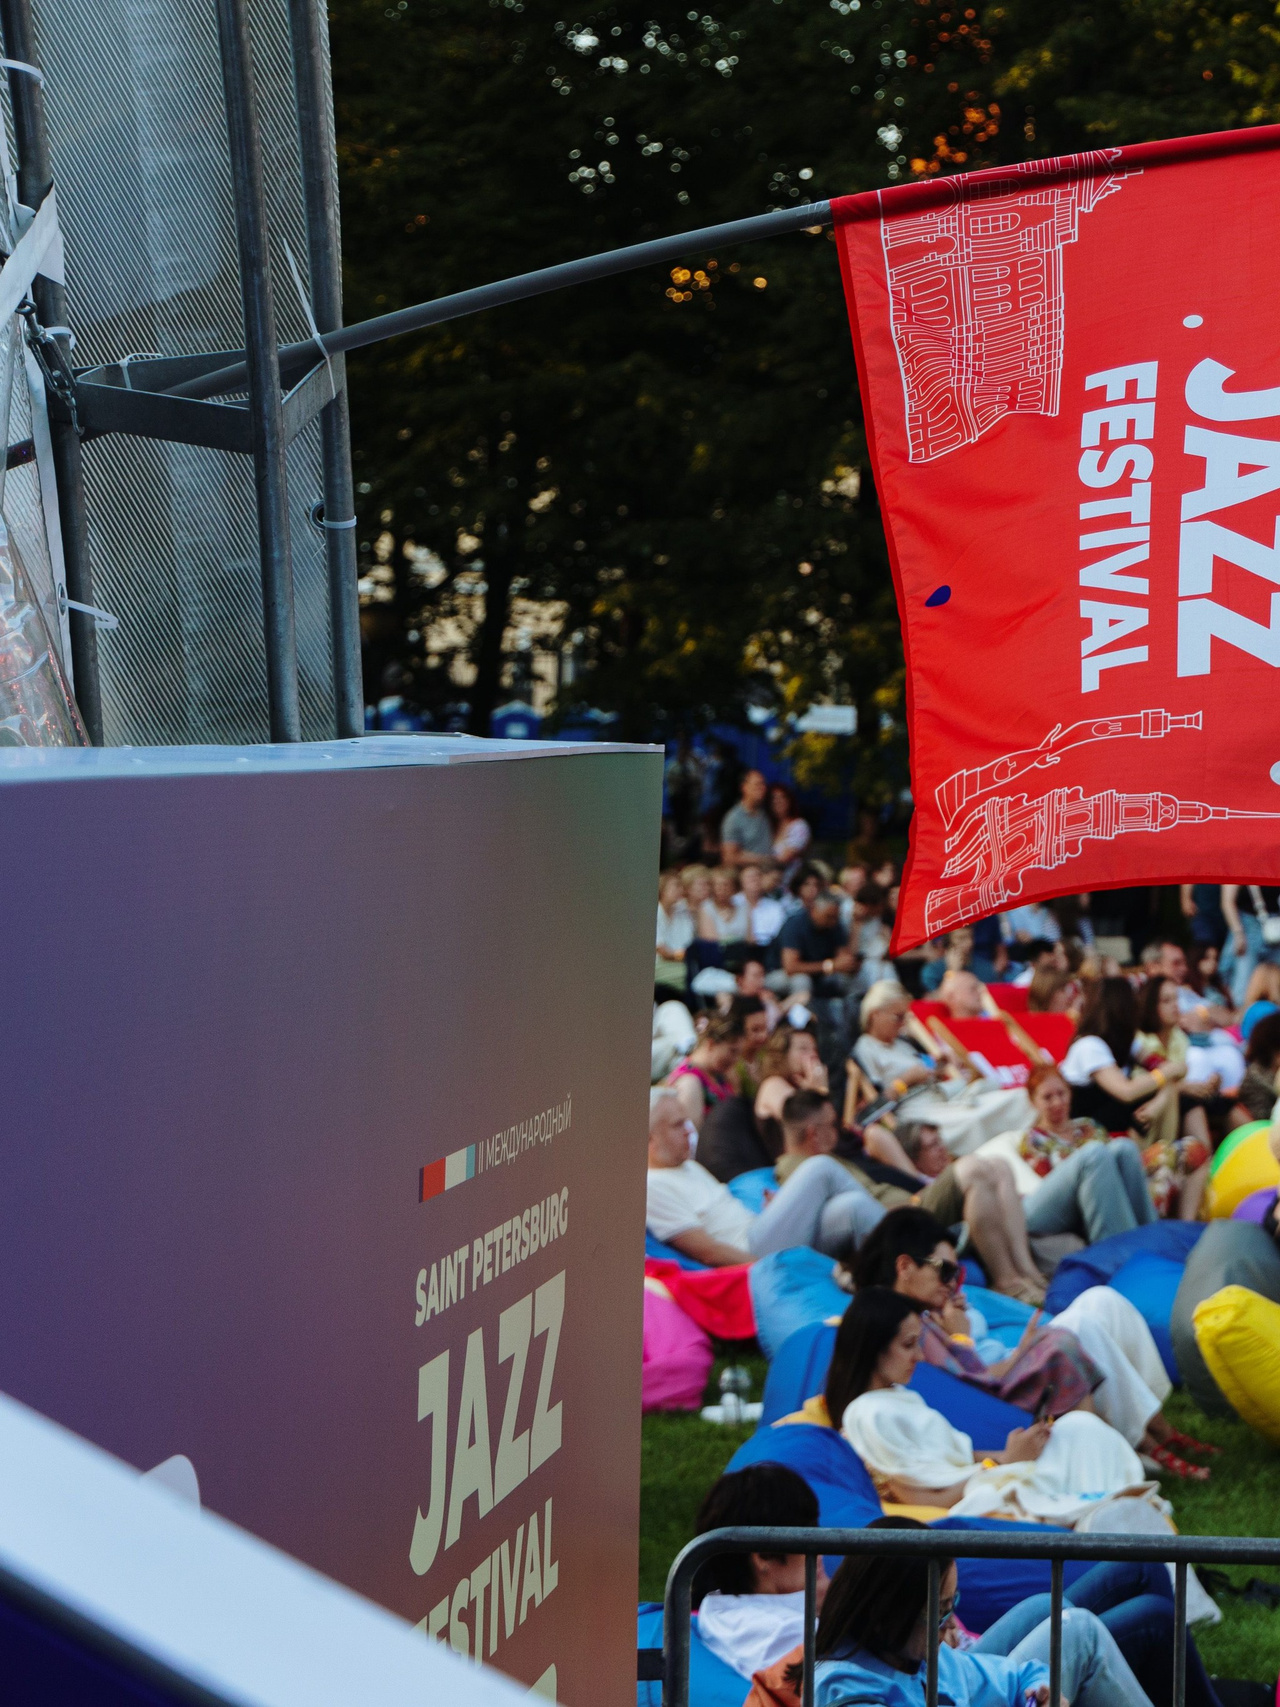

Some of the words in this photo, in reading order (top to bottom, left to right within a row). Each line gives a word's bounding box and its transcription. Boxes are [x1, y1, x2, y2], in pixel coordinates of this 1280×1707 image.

[1078, 360, 1159, 693] FESTIVAL
[486, 1092, 572, 1170] МЕЖДУНАРОДНЫЙ
[415, 1244, 469, 1327] SAINT
[472, 1186, 569, 1292] PETERSBURG
[409, 1269, 566, 1576] JAZZ
